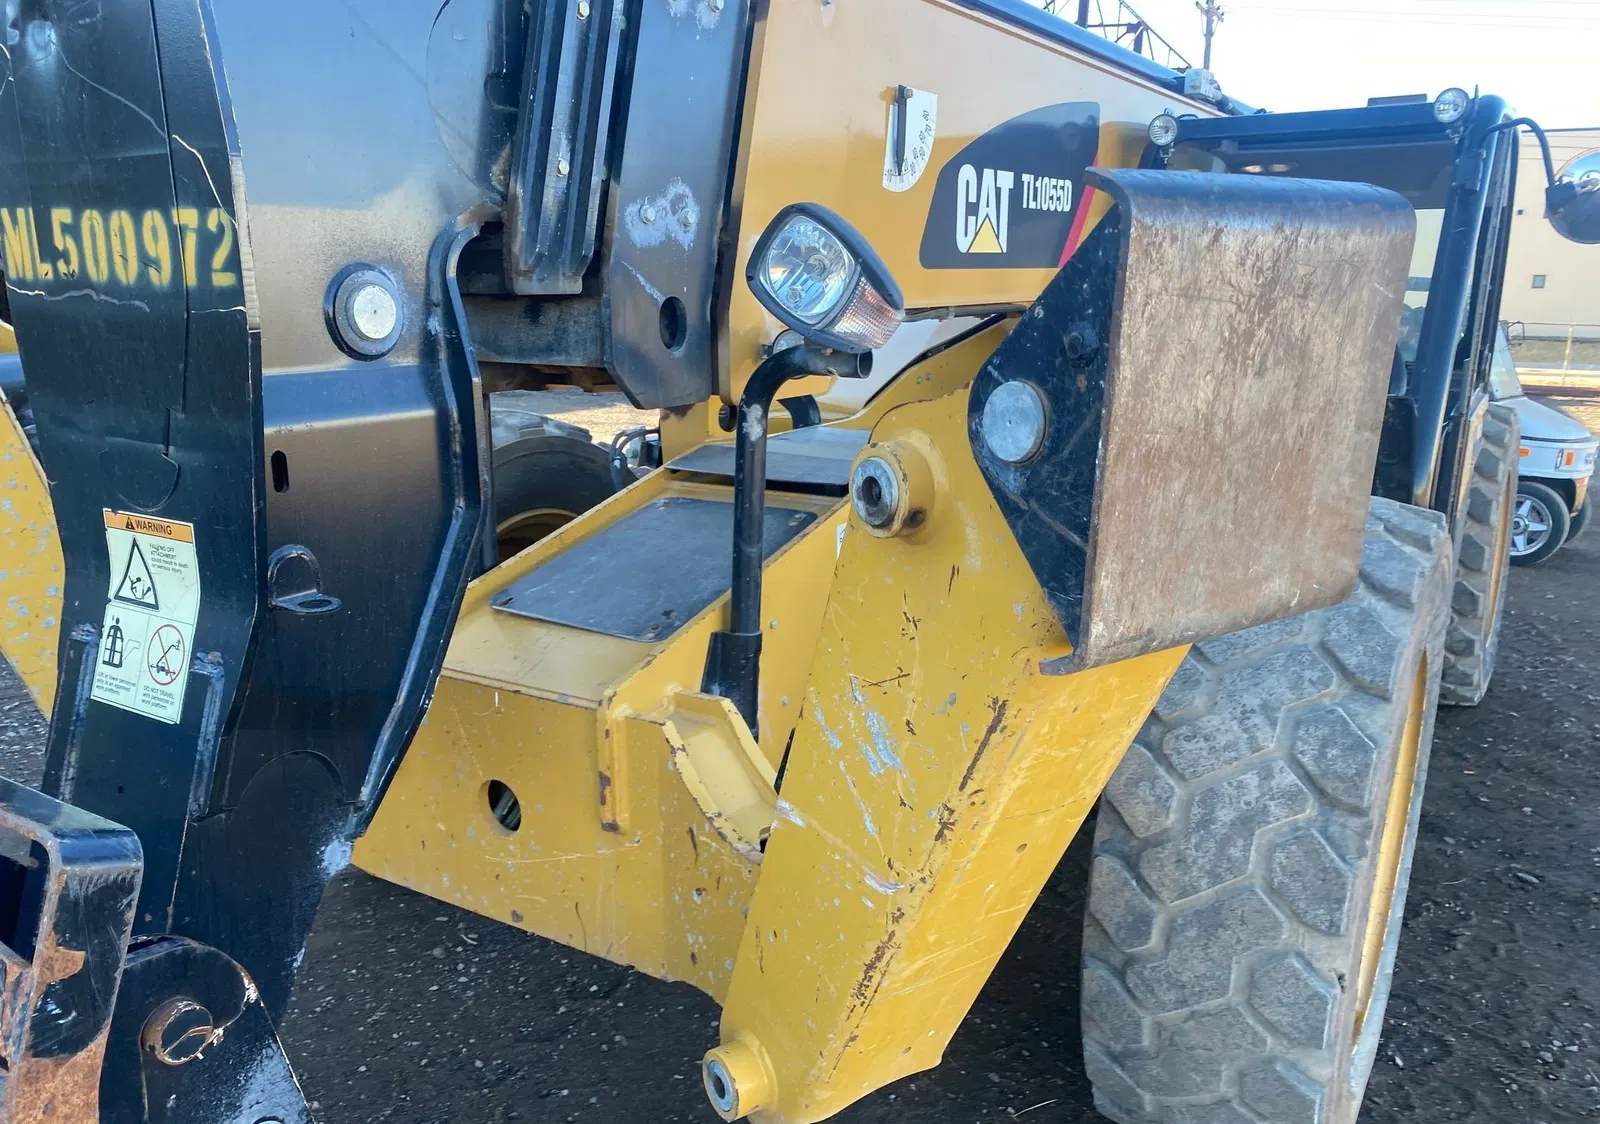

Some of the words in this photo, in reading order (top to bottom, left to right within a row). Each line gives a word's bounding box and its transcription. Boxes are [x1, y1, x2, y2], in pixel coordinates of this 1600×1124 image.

[922, 109, 930, 121] 80
[925, 124, 932, 137] 70
[956, 163, 1015, 254] CAT
[1021, 173, 1073, 212] TL1055D
[0, 206, 237, 288] ML500972
[134, 519, 173, 536] WARNING
